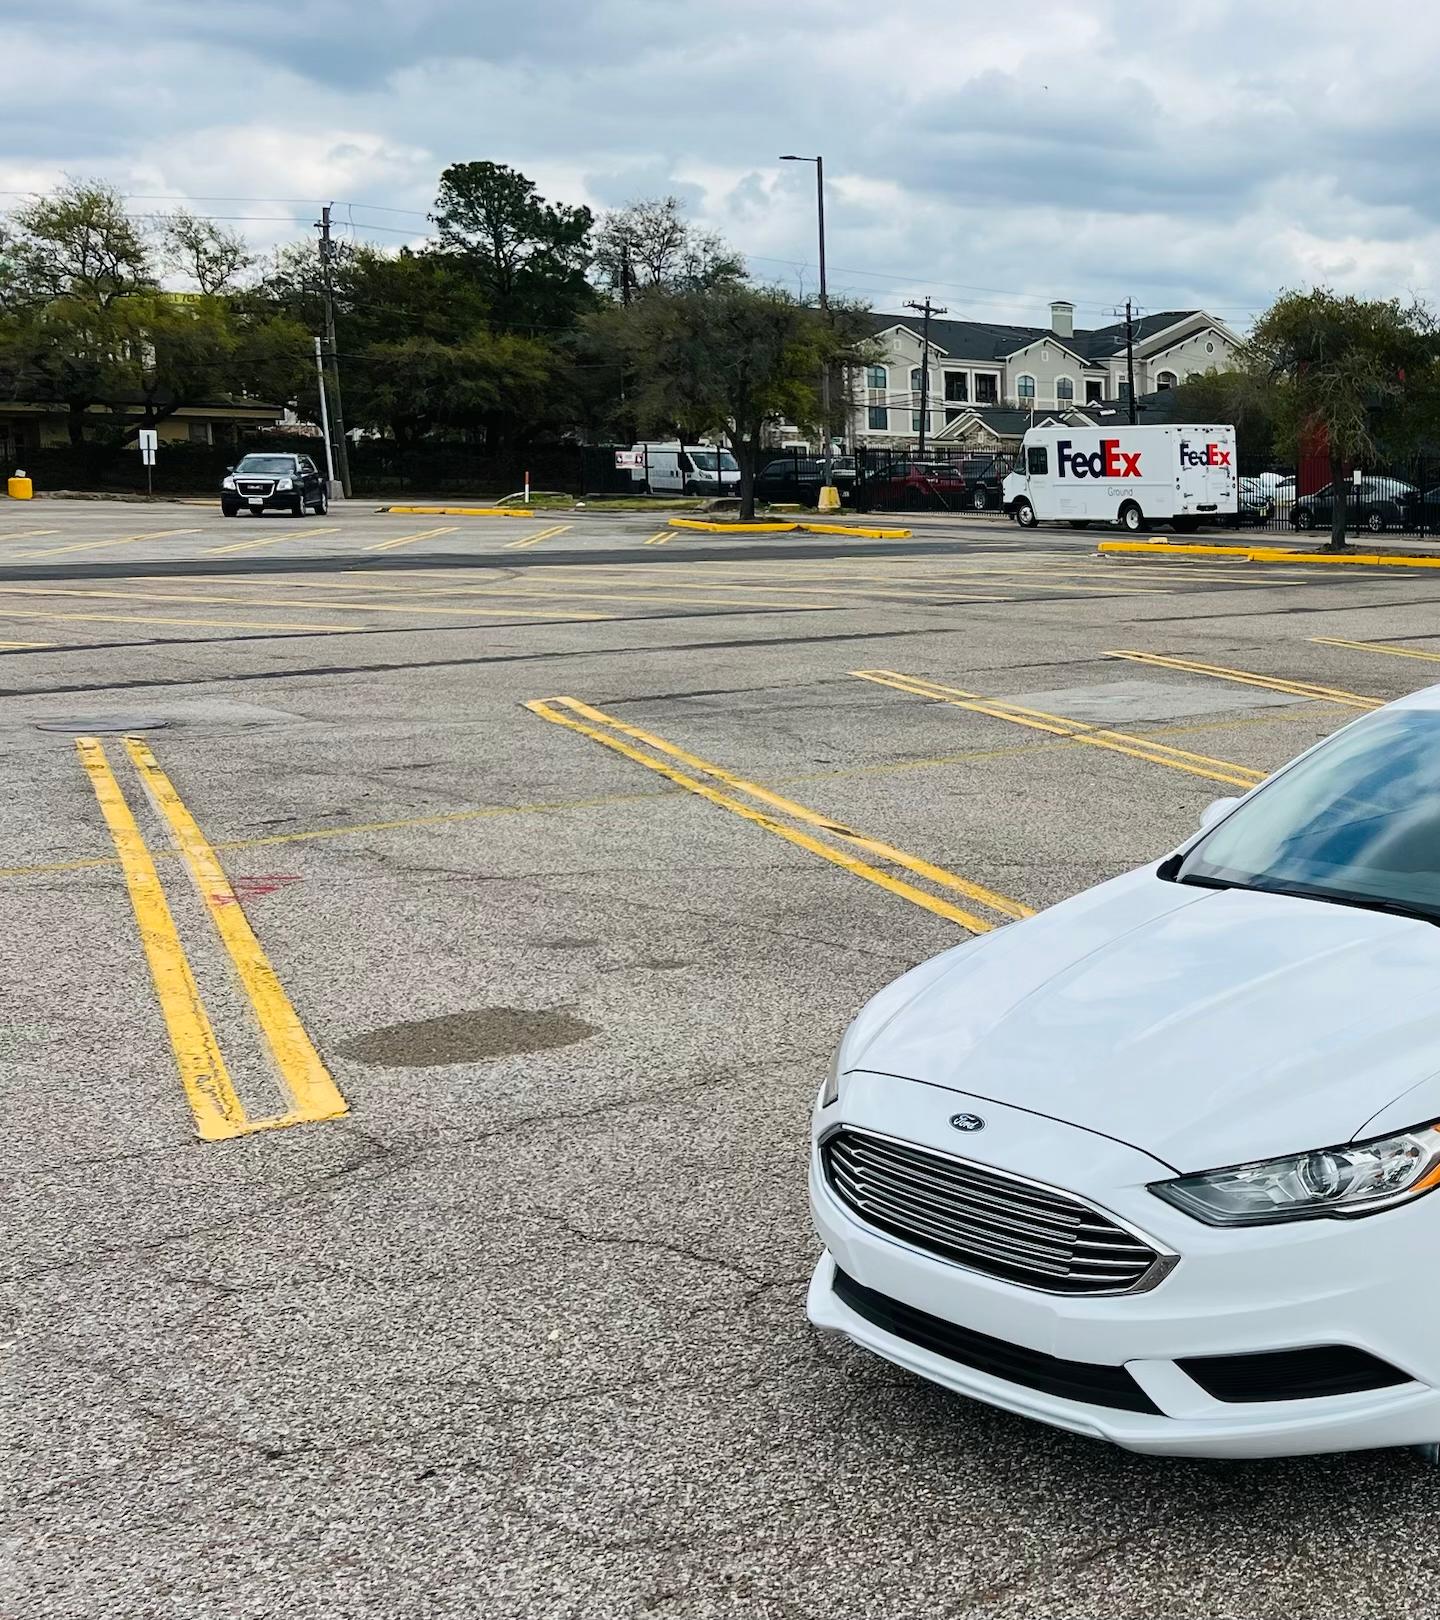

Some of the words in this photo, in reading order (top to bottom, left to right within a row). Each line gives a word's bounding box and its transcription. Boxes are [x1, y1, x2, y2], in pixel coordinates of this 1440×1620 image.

[1057, 439, 1142, 479] FedEx
[1180, 443, 1232, 466] FedEx
[1107, 486, 1133, 497] Ground
[953, 1115, 980, 1130] Ford
